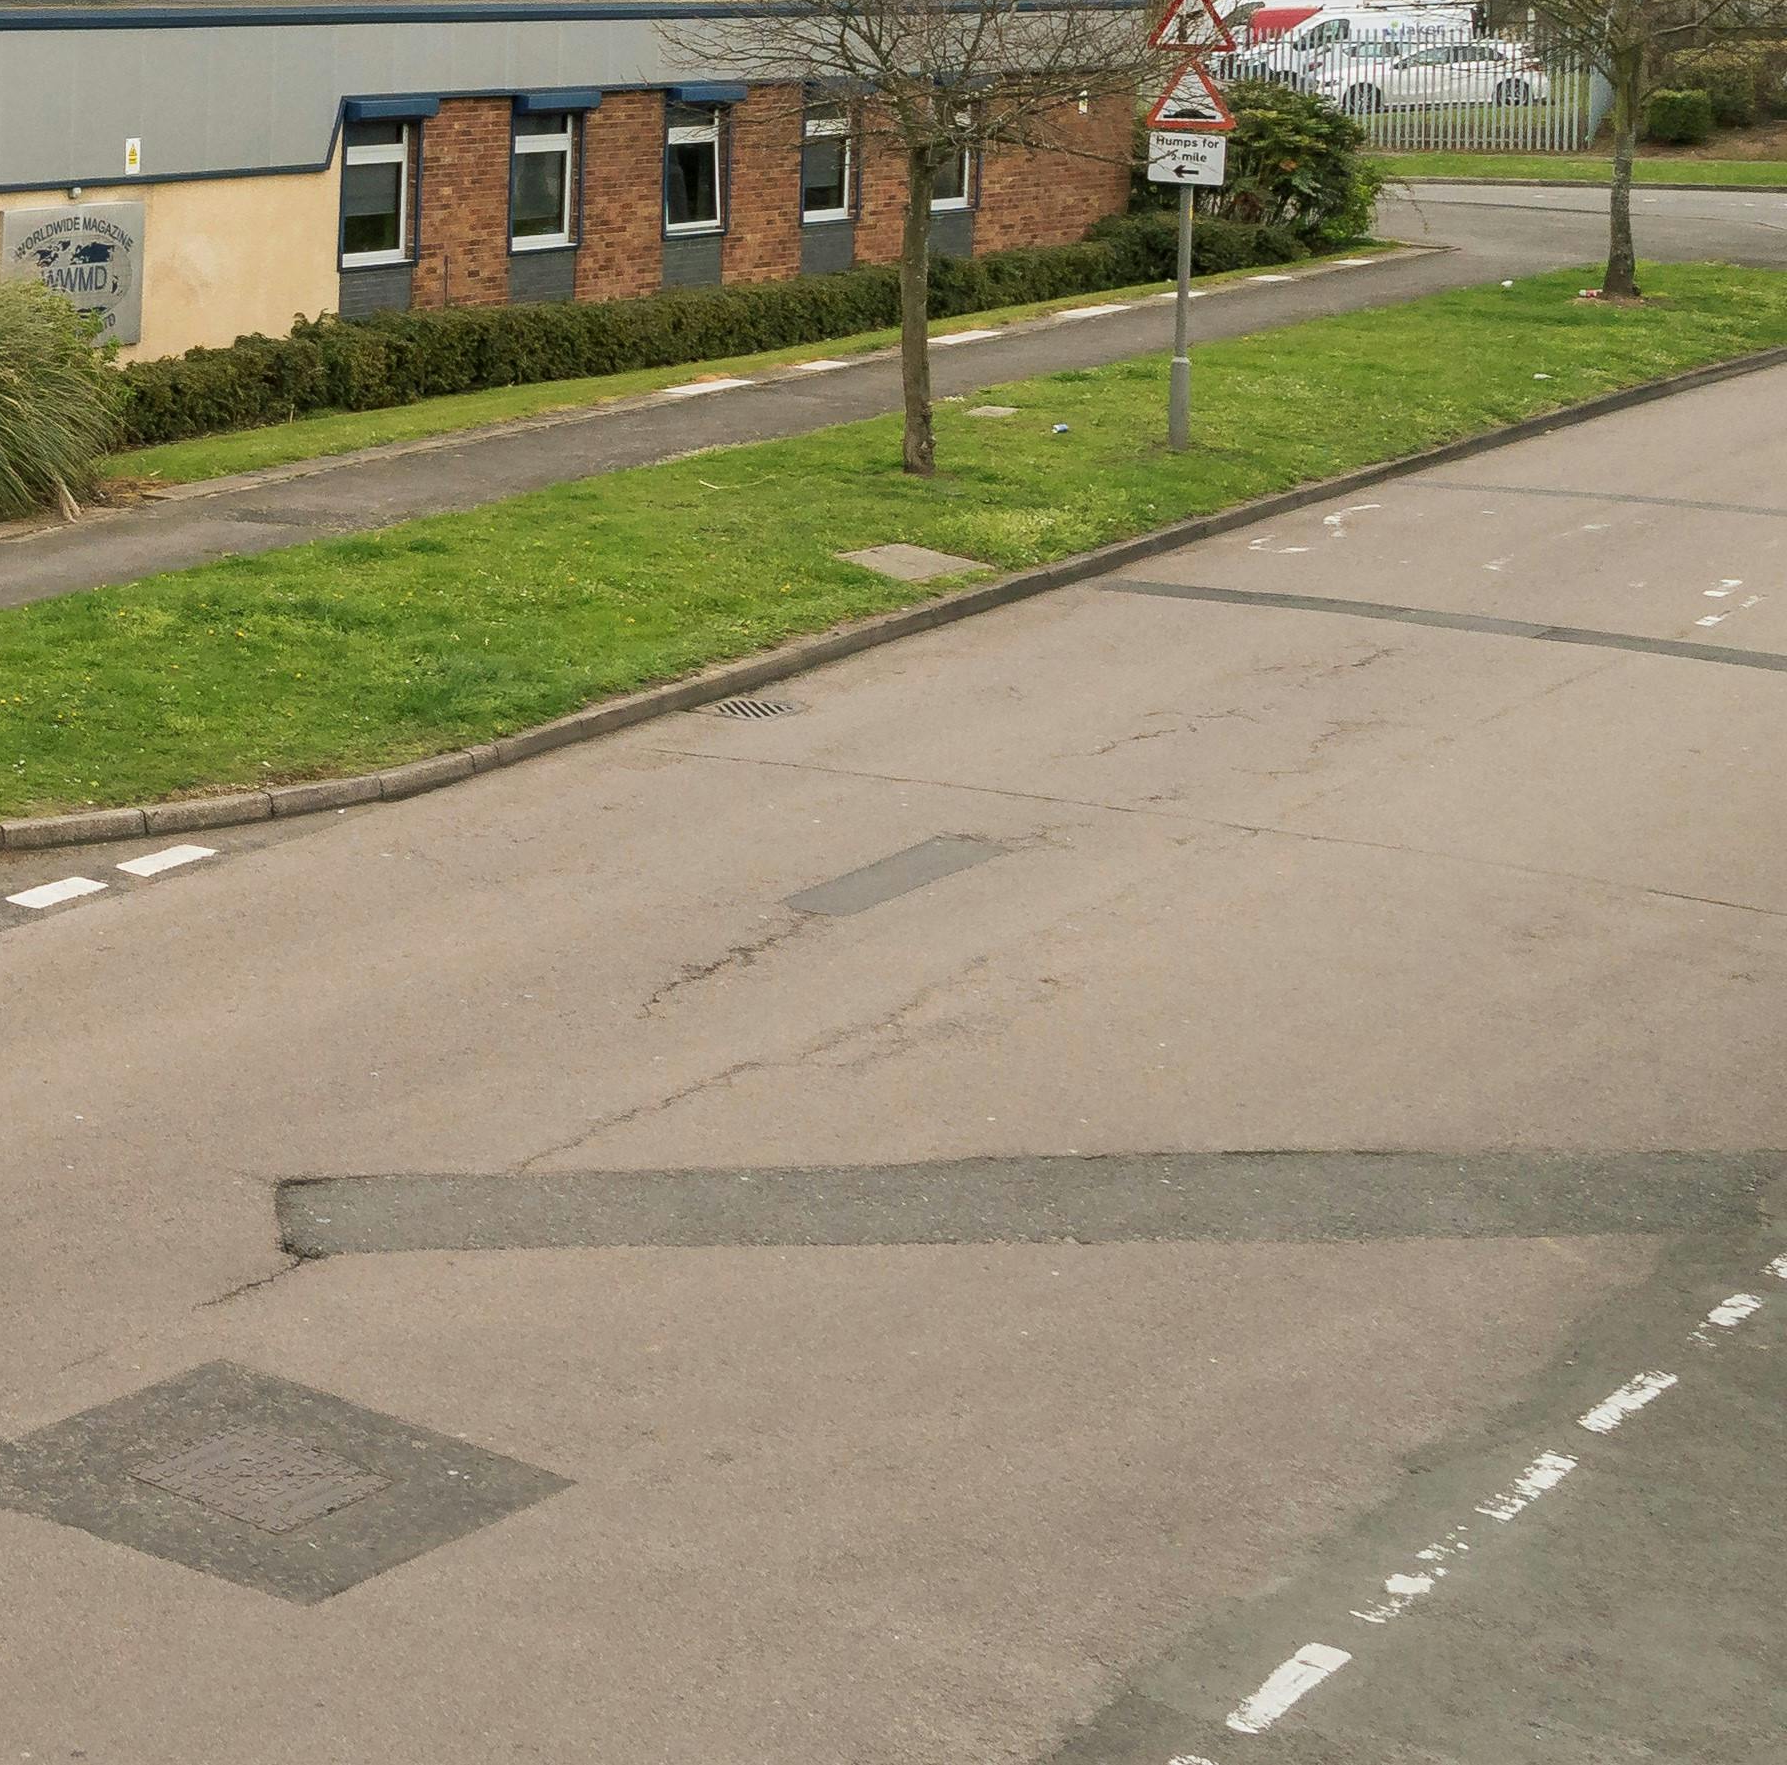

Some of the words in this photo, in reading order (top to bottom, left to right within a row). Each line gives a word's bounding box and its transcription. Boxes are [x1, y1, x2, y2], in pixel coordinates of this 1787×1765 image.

[1156, 135, 1198, 149] Humps
[1202, 138, 1220, 149] for
[1182, 152, 1207, 163] mile
[13, 216, 80, 261] WORLDWIDE
[82, 217, 134, 253] MAGAZINE
